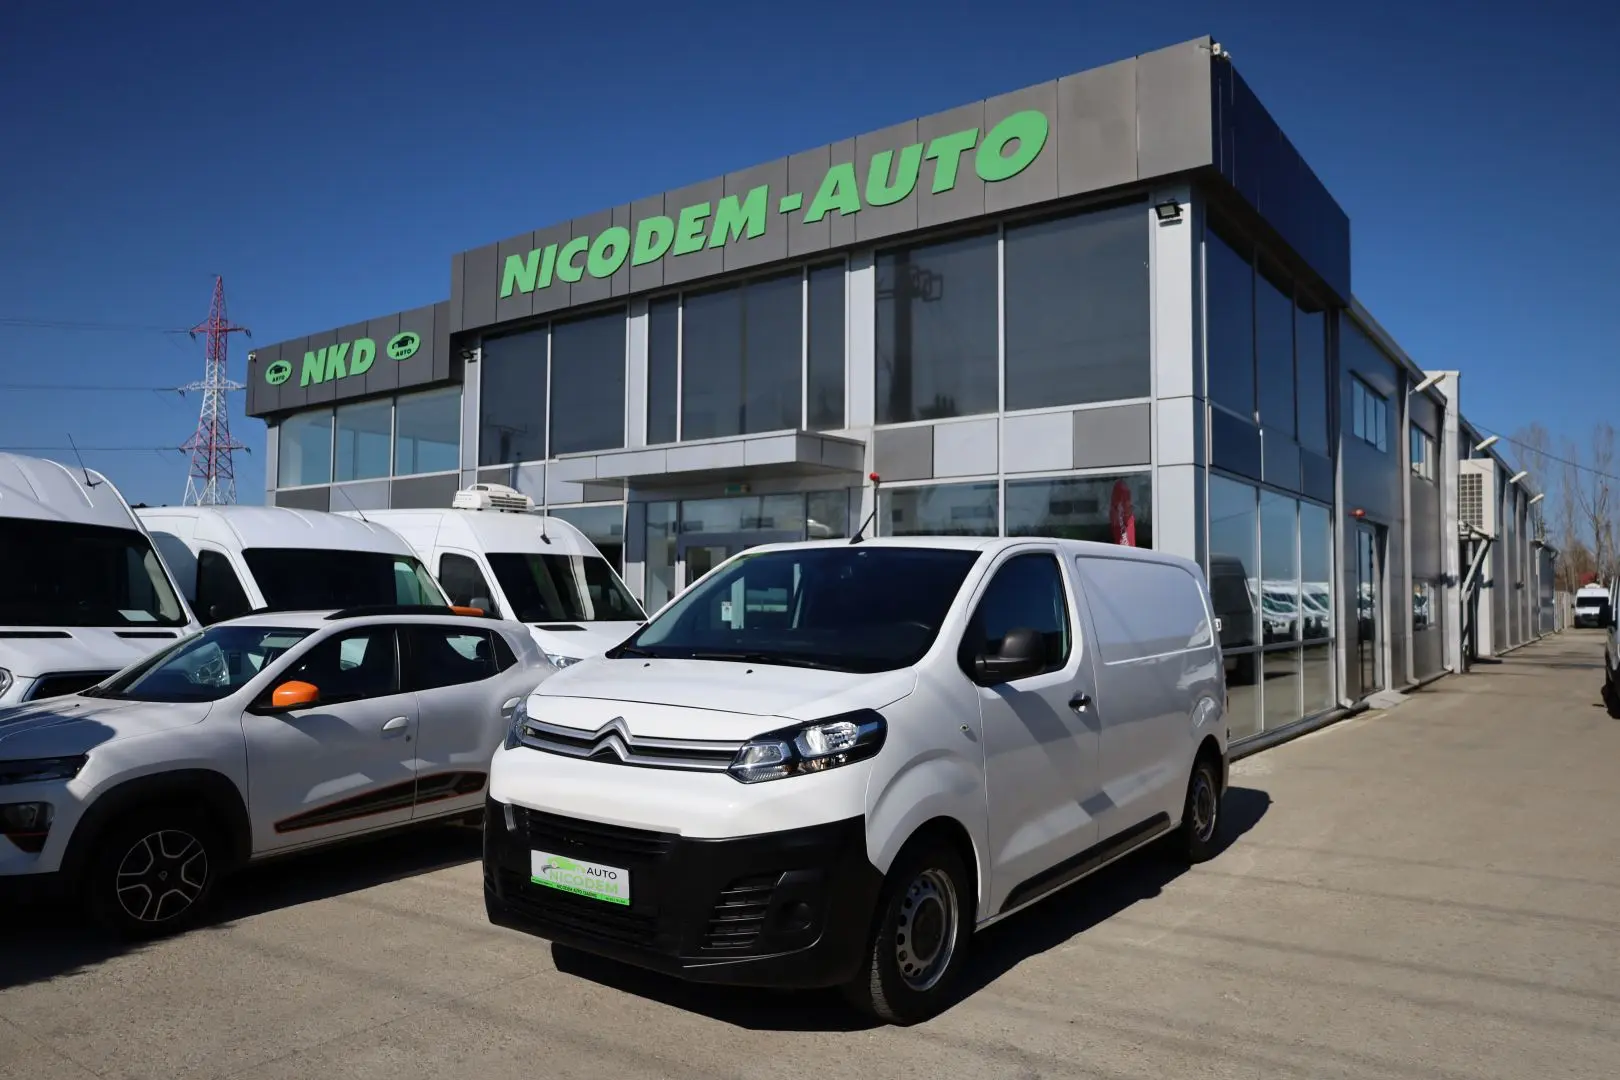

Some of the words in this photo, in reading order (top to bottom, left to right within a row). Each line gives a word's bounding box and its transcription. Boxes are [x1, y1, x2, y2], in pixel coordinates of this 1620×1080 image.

[395, 348, 412, 358] AUTO
[300, 337, 377, 388] NKD
[549, 871, 619, 894] NICODEM
[586, 867, 617, 880] AUTO
